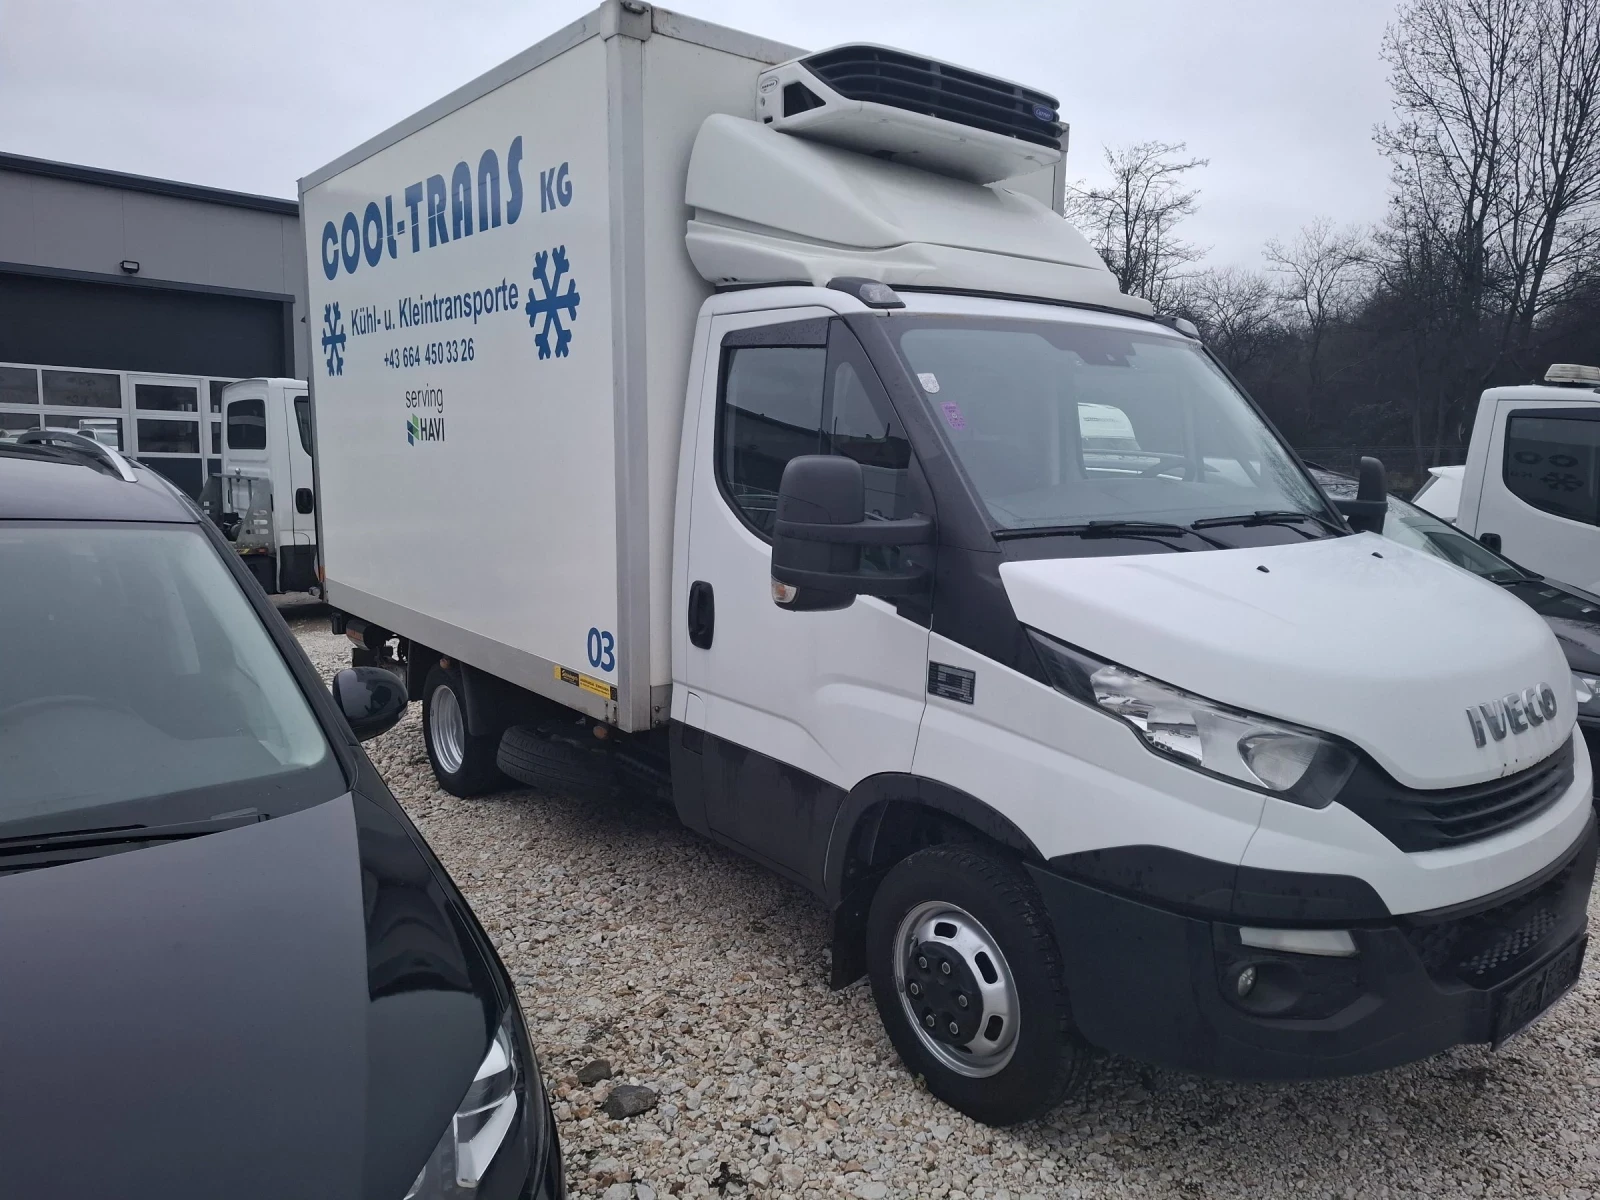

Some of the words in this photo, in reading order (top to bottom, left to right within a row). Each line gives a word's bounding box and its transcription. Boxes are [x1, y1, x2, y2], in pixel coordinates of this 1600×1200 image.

[540, 162, 573, 213] KG
[351, 305, 381, 336] Kühl-
[384, 309, 395, 331] u.
[399, 277, 519, 328] Kleintransporte
[384, 348, 400, 369] +43
[403, 345, 420, 367] 664
[405, 383, 443, 413] serving
[420, 418, 445, 441] HAVI
[587, 627, 615, 672] 03
[1465, 682, 1557, 748] IVECO
